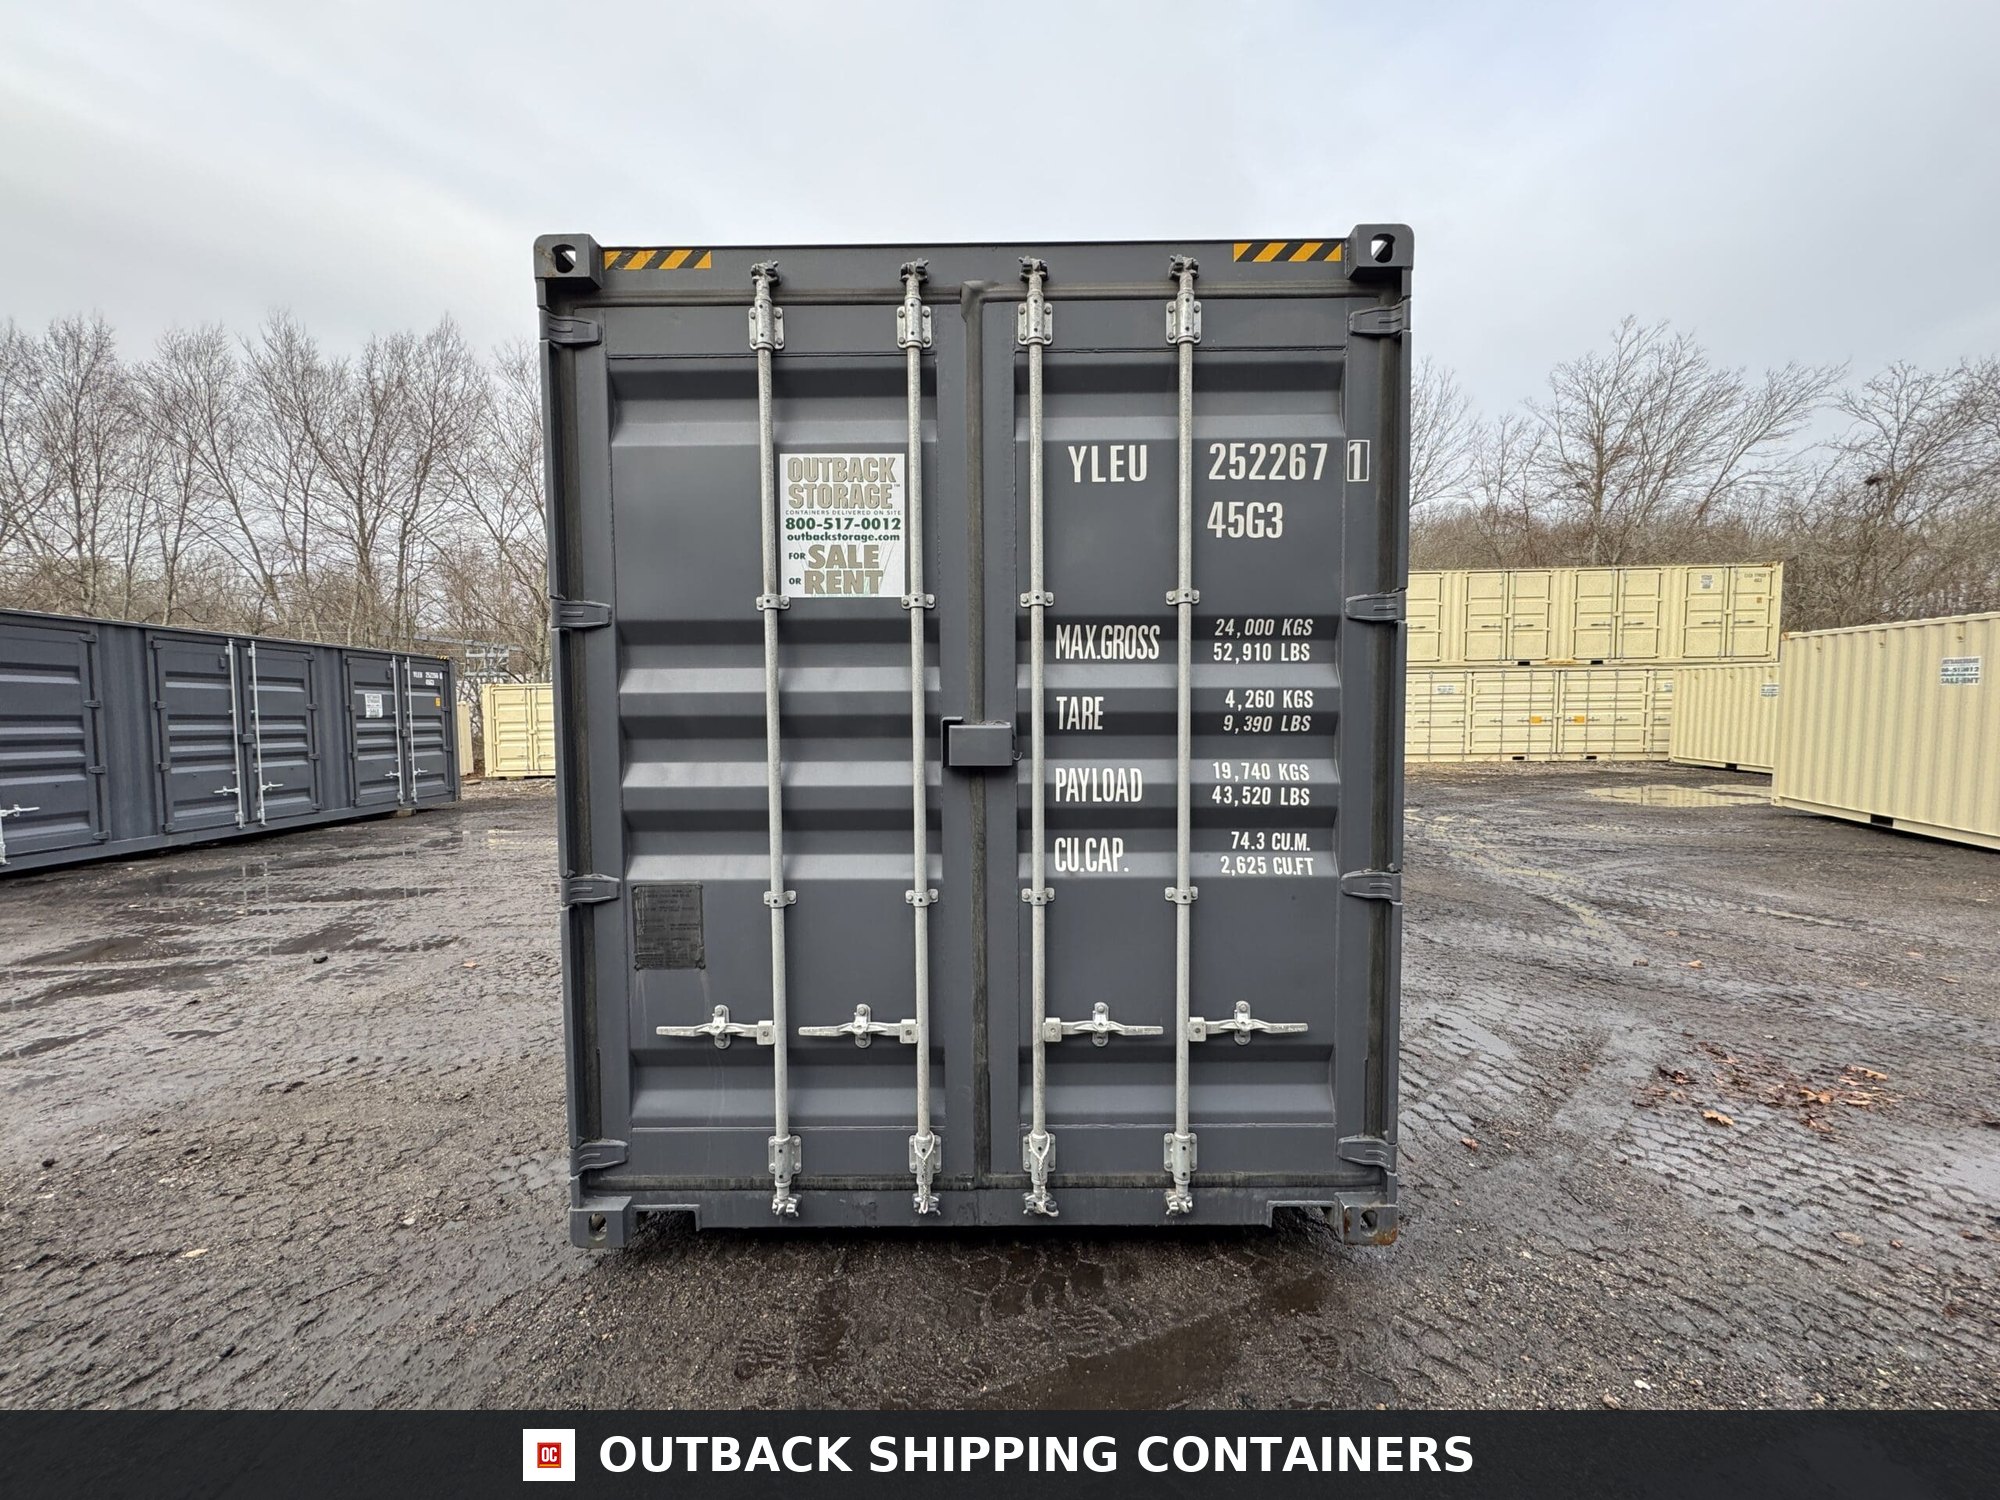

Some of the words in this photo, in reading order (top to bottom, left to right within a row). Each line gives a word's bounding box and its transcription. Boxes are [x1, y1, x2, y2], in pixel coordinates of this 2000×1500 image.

[787, 457, 897, 483] OUTBACK
[1067, 444, 1148, 483] YLEU
[1208, 442, 1328, 481] 252267
[1348, 442, 1363, 481] 1
[788, 483, 893, 510] STORAGE
[785, 517, 901, 530] 800-517-0012
[1207, 501, 1283, 539] 45G3
[787, 531, 900, 543] outbackstorage.com
[788, 552, 806, 560] FOR
[808, 544, 879, 569] SALE
[789, 577, 802, 585] OR
[804, 570, 884, 595] RENT
[1214, 618, 1275, 639] 24,000
[1281, 618, 1314, 636] KGS
[1055, 624, 1161, 660] MAX.GROSS
[1213, 642, 1272, 664] 52,910
[1280, 643, 1311, 661] LBS
[1225, 689, 1275, 711] 4,260
[1282, 689, 1314, 709] KGS
[1056, 695, 1104, 730] TARE
[1223, 715, 1273, 734] 9,390
[1280, 715, 1311, 732] LBS
[1212, 762, 1271, 783] 19,740
[1278, 763, 1310, 781] KGS
[1055, 767, 1143, 803] PAYLOAD
[1211, 785, 1271, 808] 43,520
[1279, 787, 1310, 806] LBS
[1231, 831, 1265, 850] 74.3
[1271, 832, 1311, 852] CU.M.
[1054, 837, 1129, 873] CU.CAP.
[1220, 855, 1267, 877] 2,625
[1273, 857, 1314, 876] CU.FT
